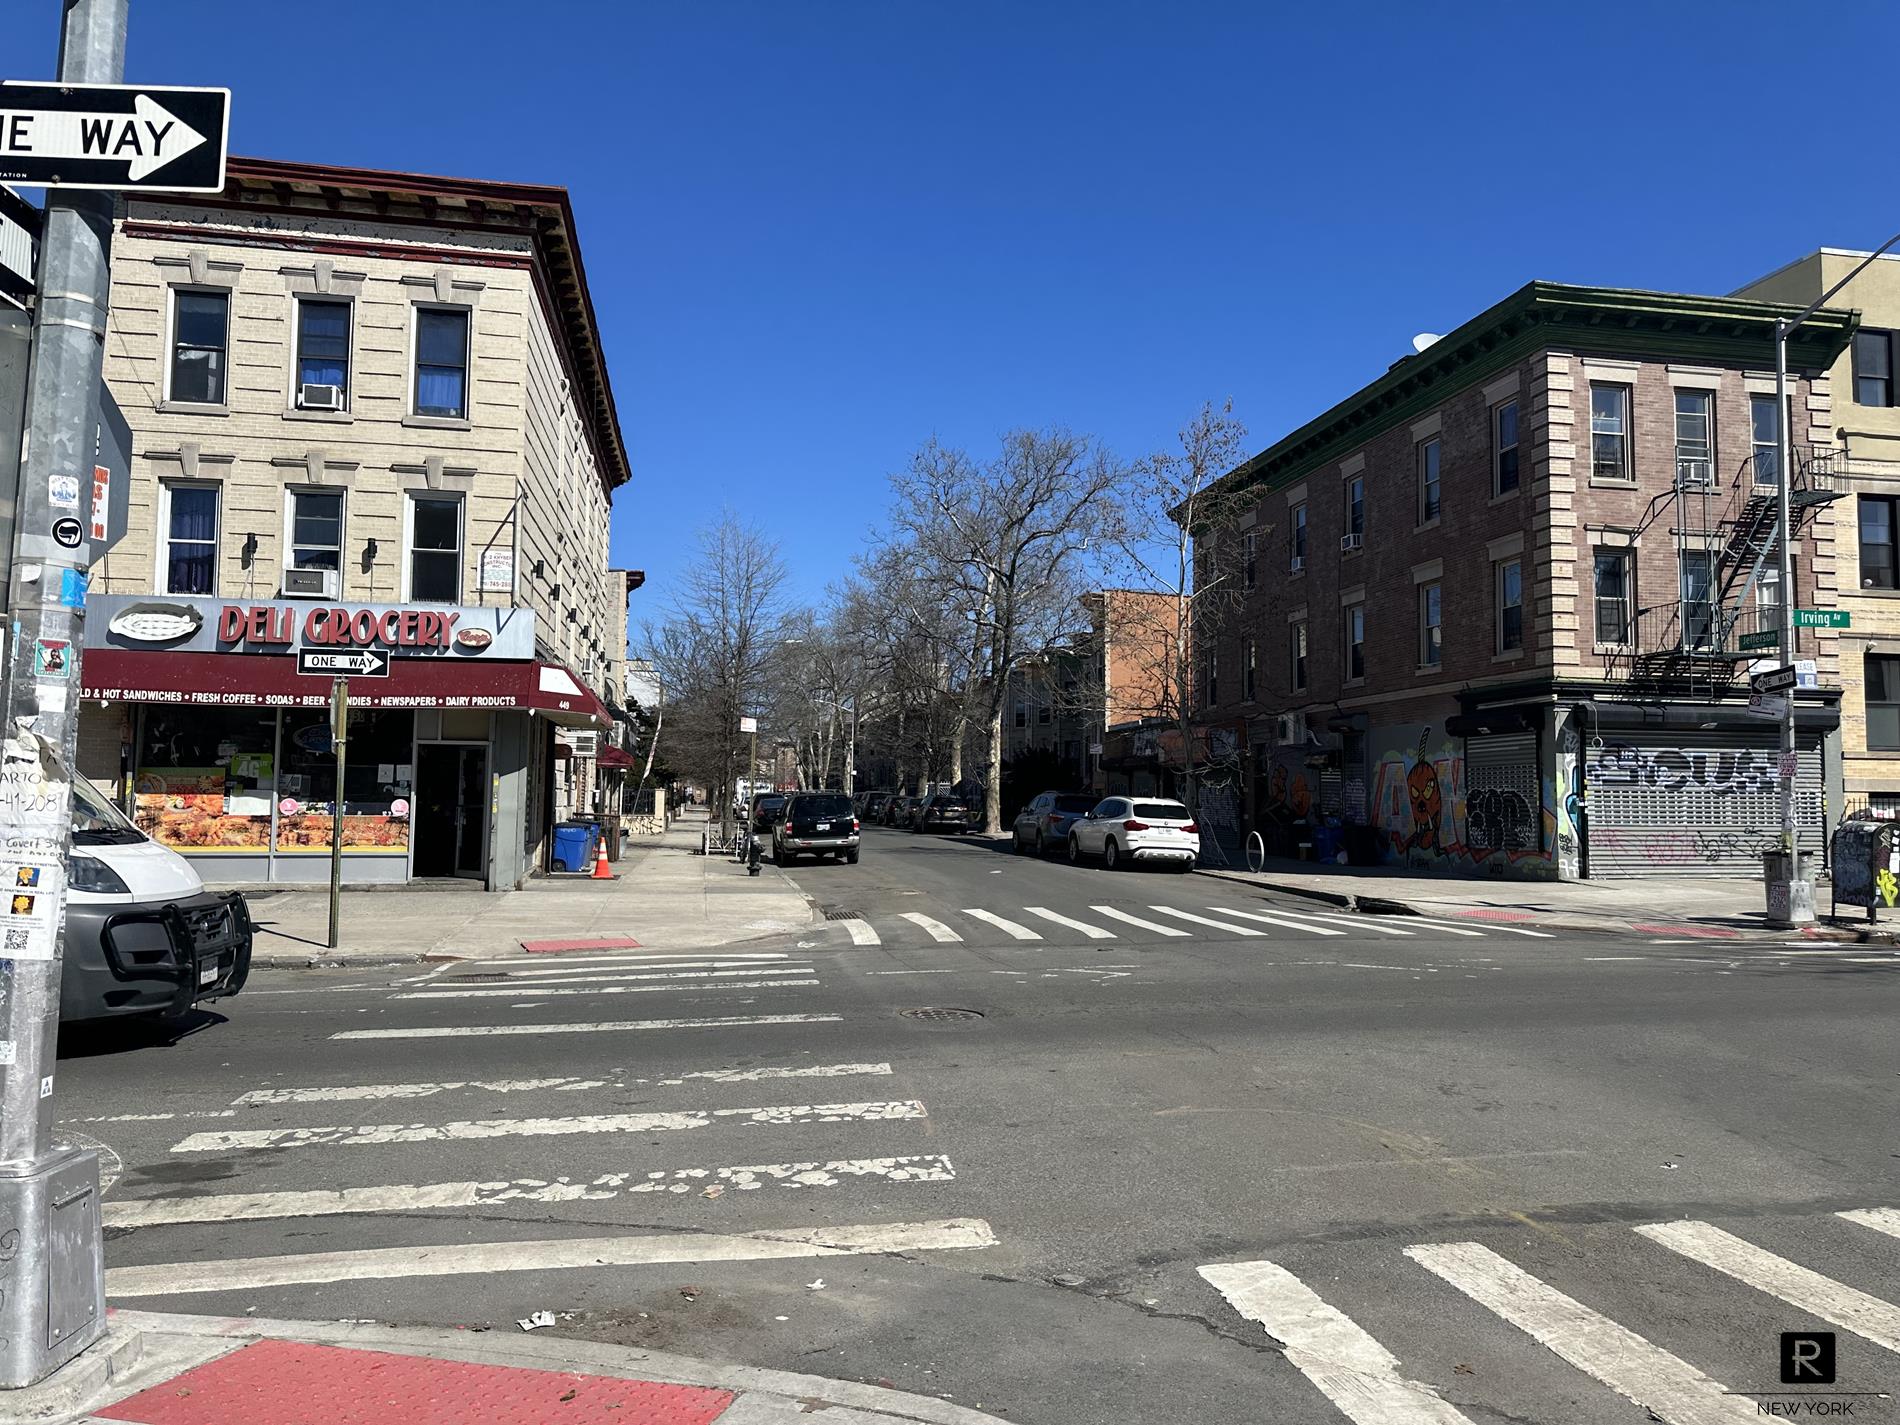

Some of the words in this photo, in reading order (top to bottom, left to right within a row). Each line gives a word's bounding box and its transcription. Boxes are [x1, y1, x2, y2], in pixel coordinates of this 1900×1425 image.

[0, 115, 34, 152] E
[80, 118, 175, 157] WAY
[219, 605, 294, 644] DELI
[304, 607, 460, 647] GROCERY
[1801, 611, 1830, 627] Irving
[1833, 612, 1841, 621] Av
[1743, 633, 1776, 645] Jefferson
[311, 656, 337, 667] ONE
[348, 657, 375, 668] WAY
[1758, 677, 1773, 689] ONE
[1777, 673, 1792, 684] WAY
[93, 688, 101, 698] &
[102, 689, 121, 699] HOT
[122, 689, 183, 702] SANDWICHES
[191, 692, 221, 704] FRESH
[222, 693, 257, 705] COFFEE
[265, 694, 294, 705] SODAS
[302, 695, 325, 706] BEER
[346, 696, 372, 706] NDIES
[380, 696, 437, 706] NEWSPAPERS
[445, 696, 470, 706] DAIRY
[471, 696, 516, 706] PRODUCTS
[559, 700, 570, 710] 449
